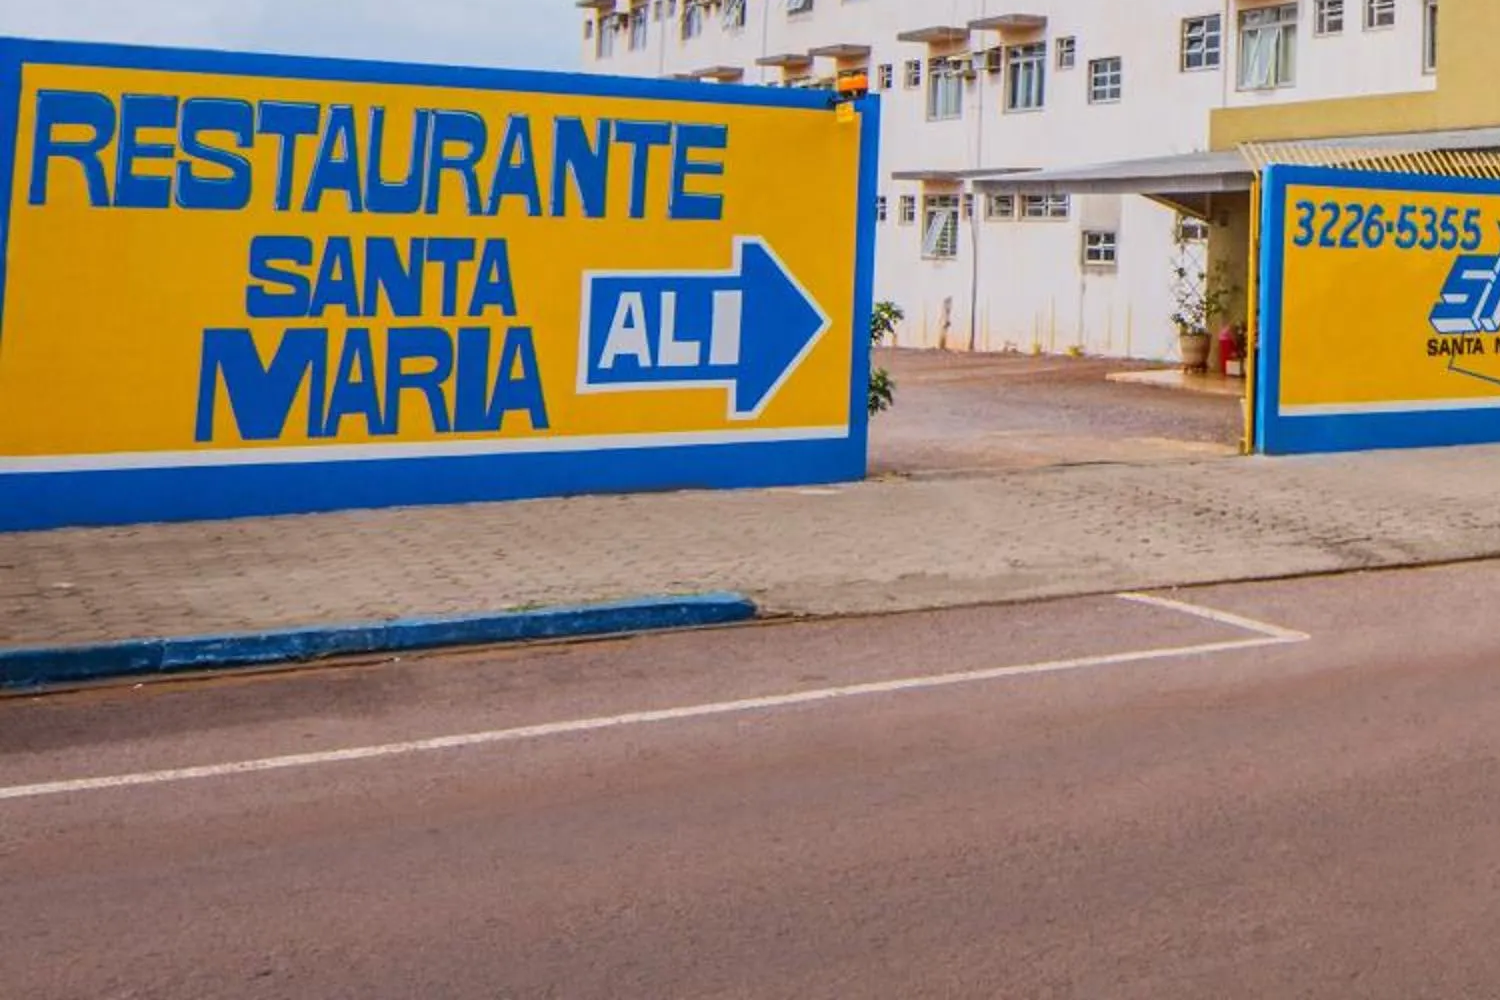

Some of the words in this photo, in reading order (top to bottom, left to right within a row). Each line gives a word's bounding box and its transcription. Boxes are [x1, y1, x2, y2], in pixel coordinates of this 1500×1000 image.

[28, 89, 728, 220] RESTAURANTE
[246, 235, 517, 318] SANTA
[598, 289, 743, 370] ALI
[1427, 337, 1485, 356] SANTA
[195, 325, 549, 442] MARIA
